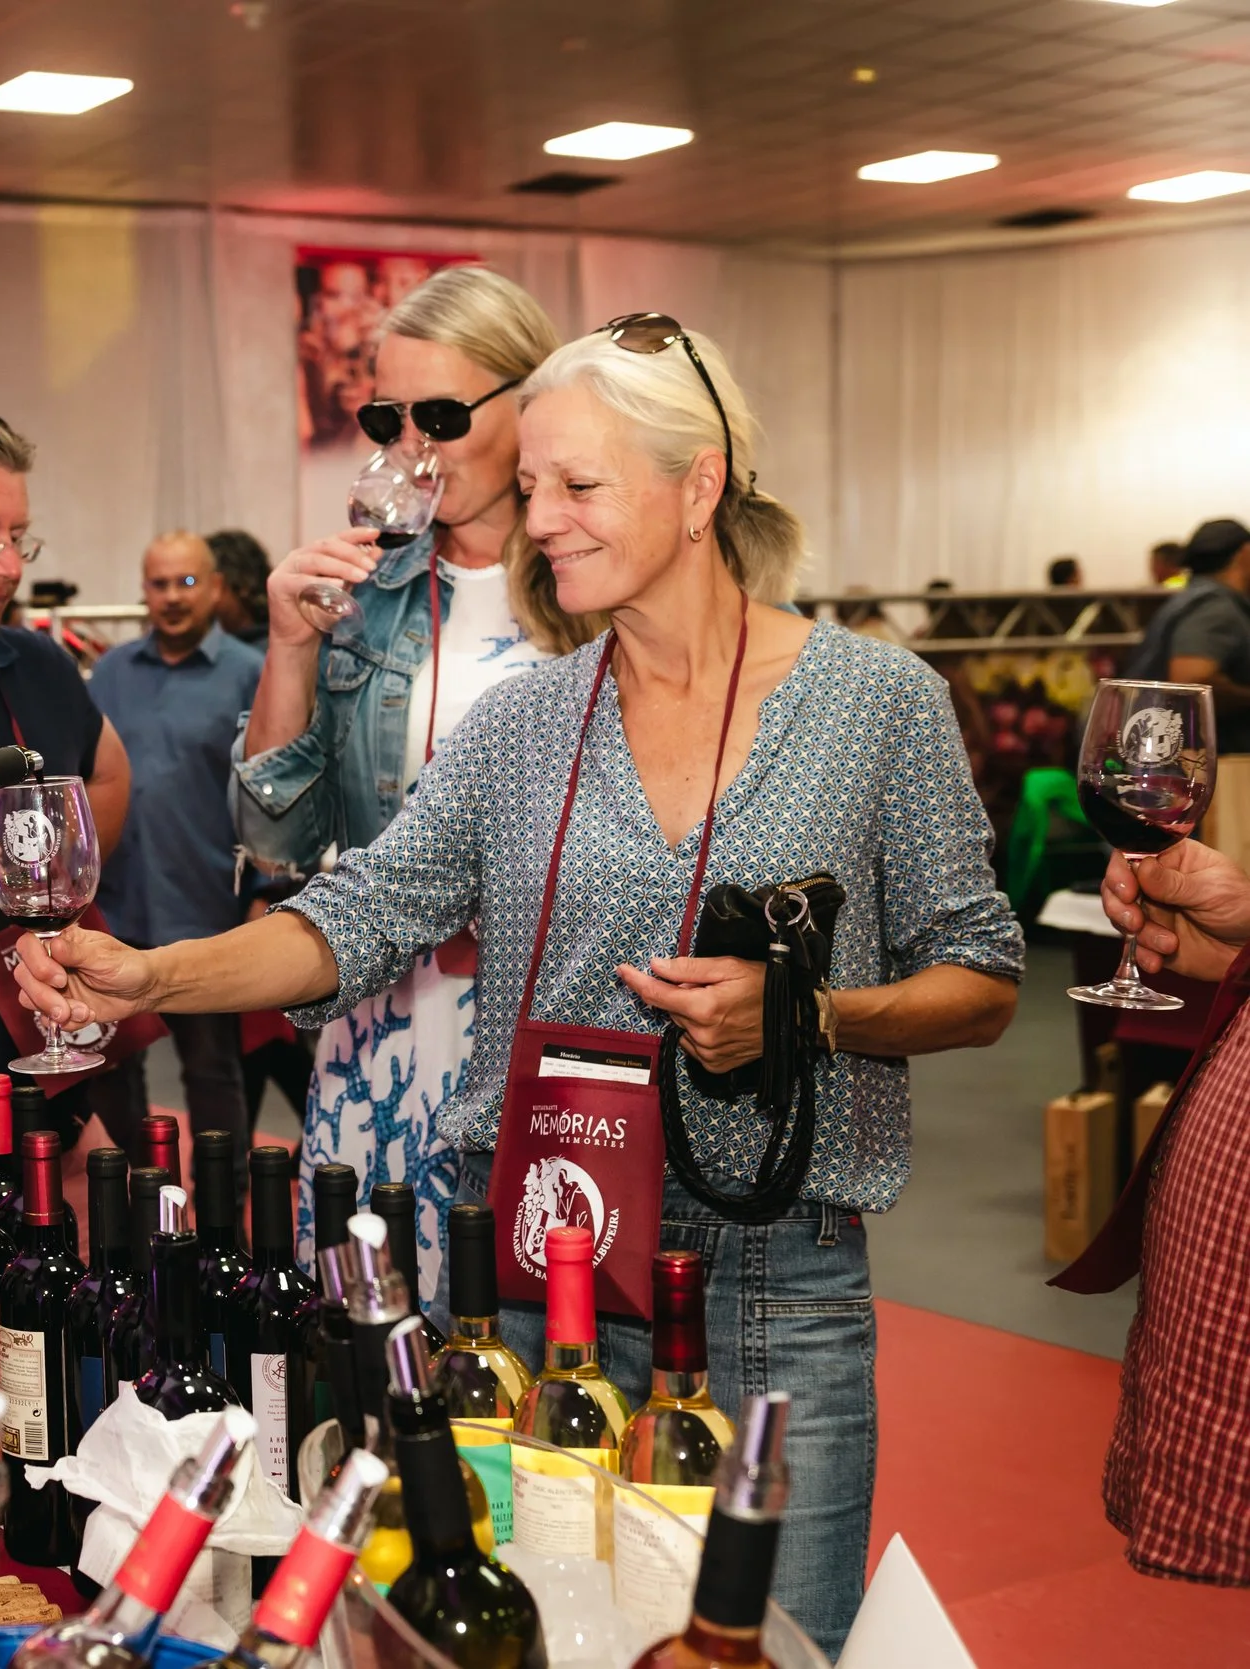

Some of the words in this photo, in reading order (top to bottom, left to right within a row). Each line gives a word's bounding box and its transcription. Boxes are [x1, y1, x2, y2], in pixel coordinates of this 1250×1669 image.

[529, 1108, 627, 1140] MEMÓRIAS
[559, 1136, 625, 1149] MEMORIES
[520, 1259, 534, 1274] DO
